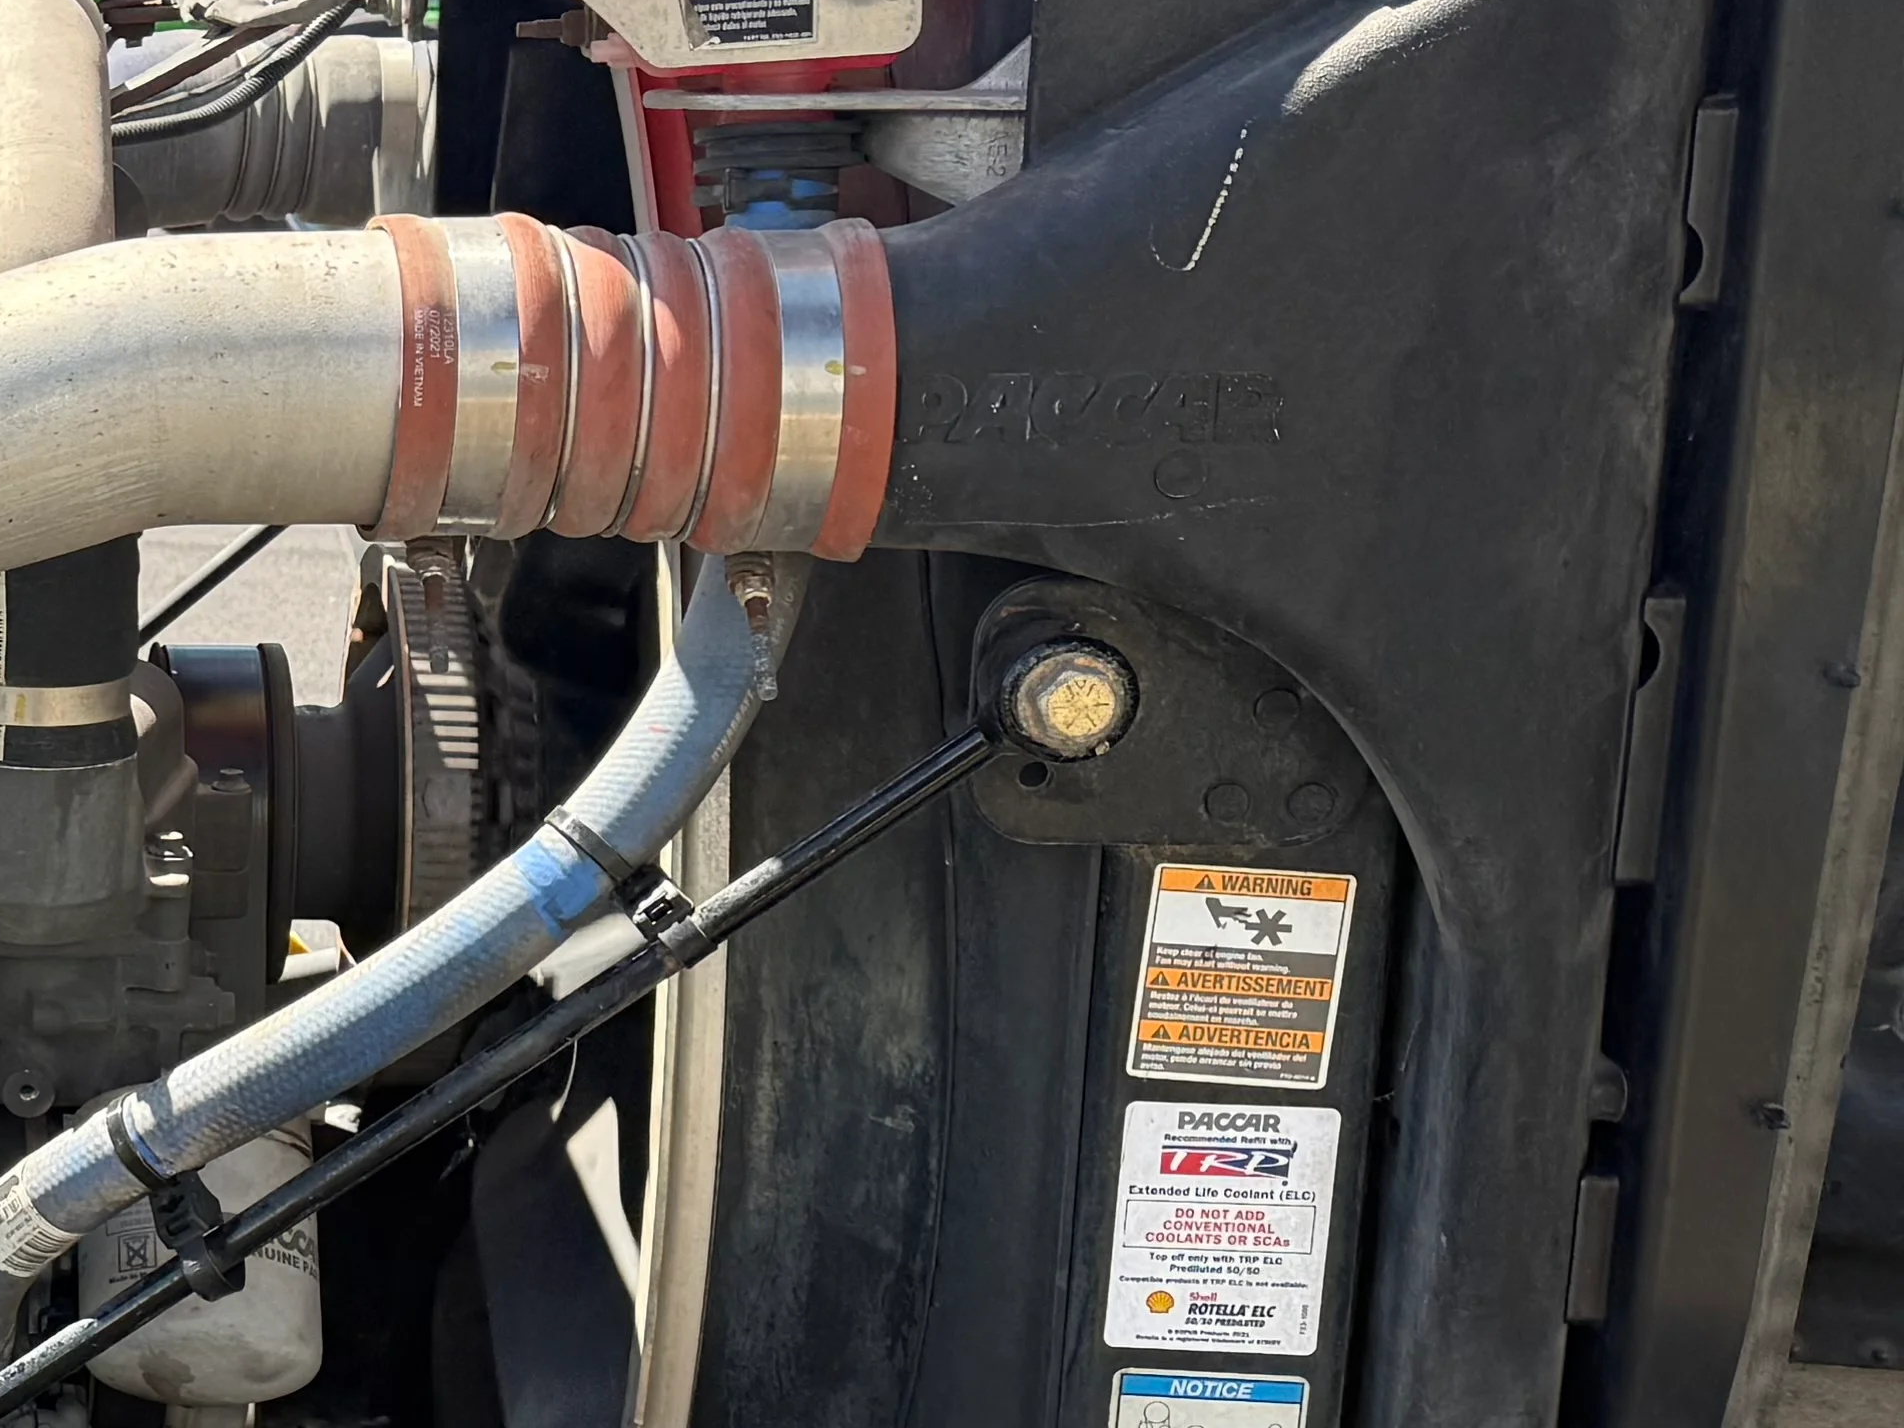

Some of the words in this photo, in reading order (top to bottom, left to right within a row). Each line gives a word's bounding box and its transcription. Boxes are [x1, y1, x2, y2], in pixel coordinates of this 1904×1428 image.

[1219, 874, 1313, 896] WARNING
[1175, 971, 1330, 997] AVERTISSEMENT
[1177, 1024, 1312, 1050] ADVERTENCIA
[1176, 1110, 1282, 1134] PACCAR
[1159, 1145, 1291, 1178] TRP
[1127, 1183, 1190, 1197] Extended
[1194, 1186, 1219, 1199] Life
[1222, 1187, 1275, 1201] Coolant
[1278, 1190, 1316, 1203] (ELC)
[1174, 1207, 1195, 1218] DO
[1199, 1208, 1230, 1220] NOT
[1233, 1209, 1265, 1222] ADD
[1162, 1218, 1276, 1235] CONVENTIONAL
[1144, 1230, 1222, 1245] COOLANTS
[1227, 1234, 1248, 1246] OR
[1252, 1235, 1291, 1248] SCAs
[1188, 1291, 1218, 1302] Shell
[1187, 1302, 1246, 1317] ROTELLA
[1250, 1305, 1276, 1319] ELC
[1168, 1378, 1254, 1399] NOTICE
